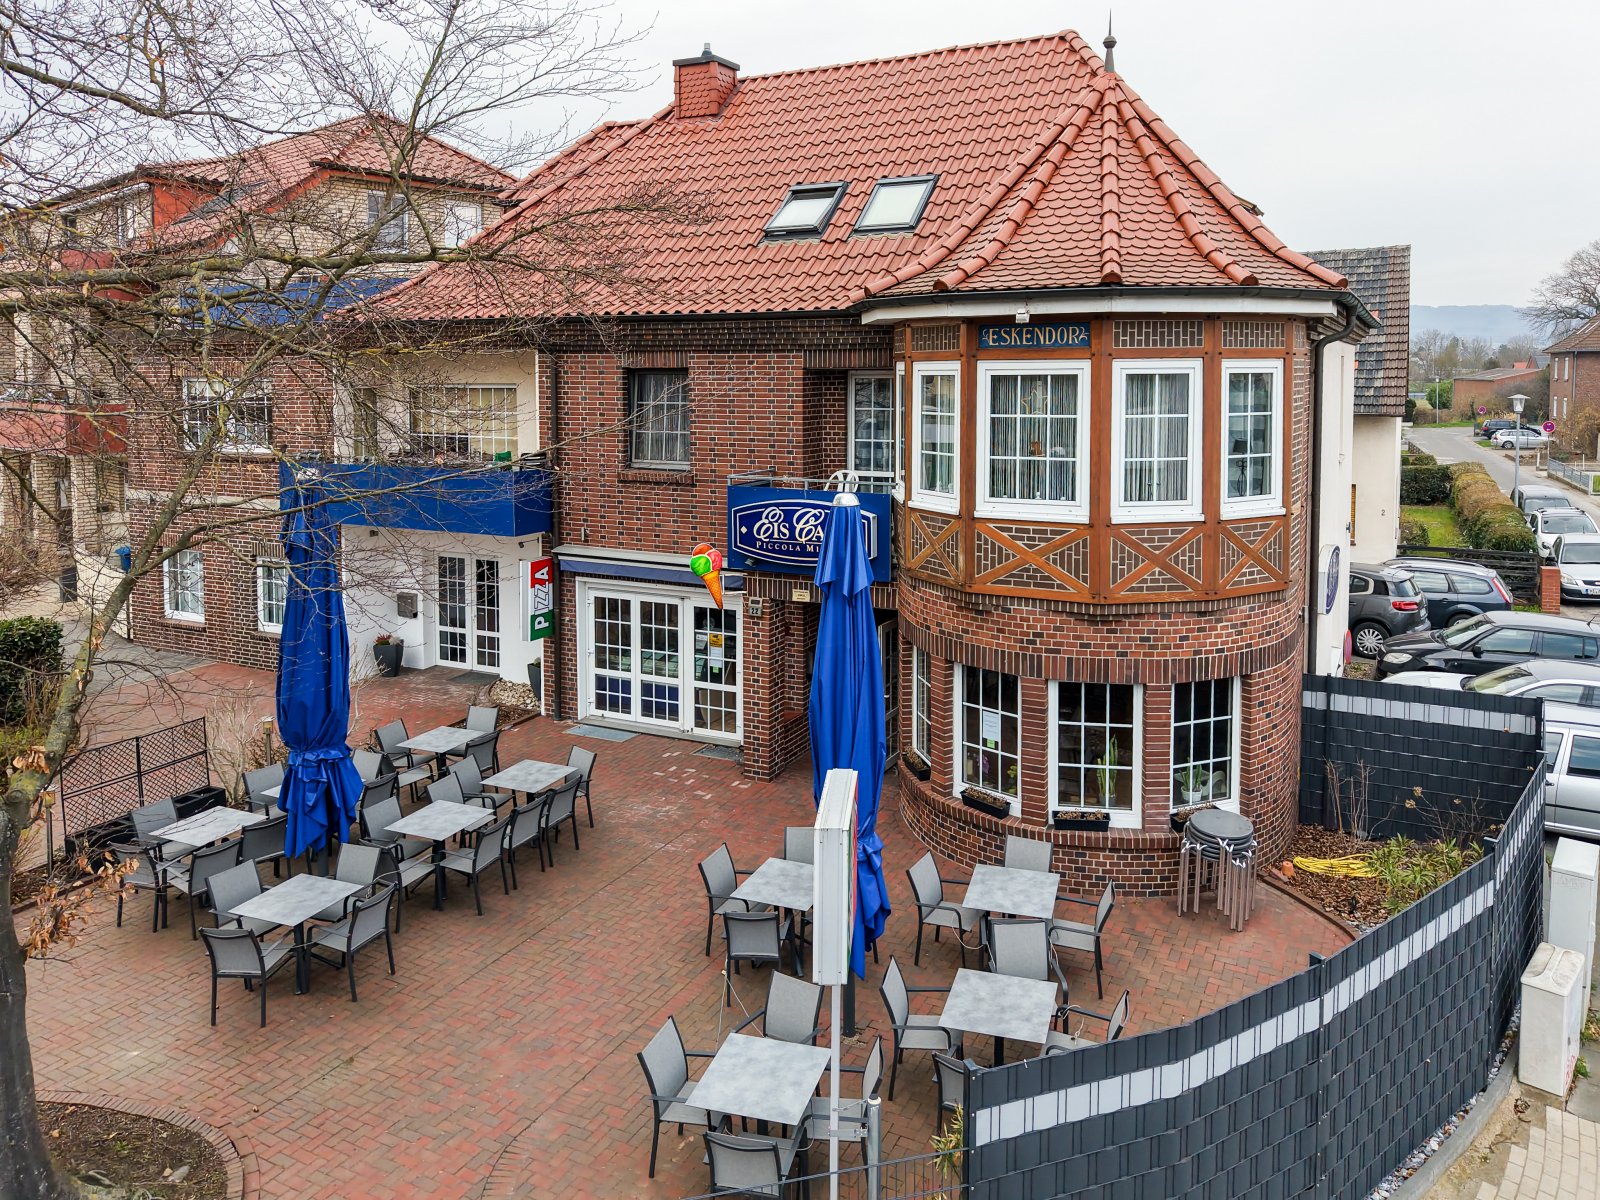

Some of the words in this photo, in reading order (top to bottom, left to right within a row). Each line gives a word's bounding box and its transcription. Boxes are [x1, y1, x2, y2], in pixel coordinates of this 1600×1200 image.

[988, 326, 1079, 346] ESKENDOR
[793, 507, 824, 544] CA
[756, 540, 801, 552] PICCOLA
[806, 544, 819, 553] MI
[533, 565, 550, 631] PIZZA
[751, 607, 759, 615] 22
